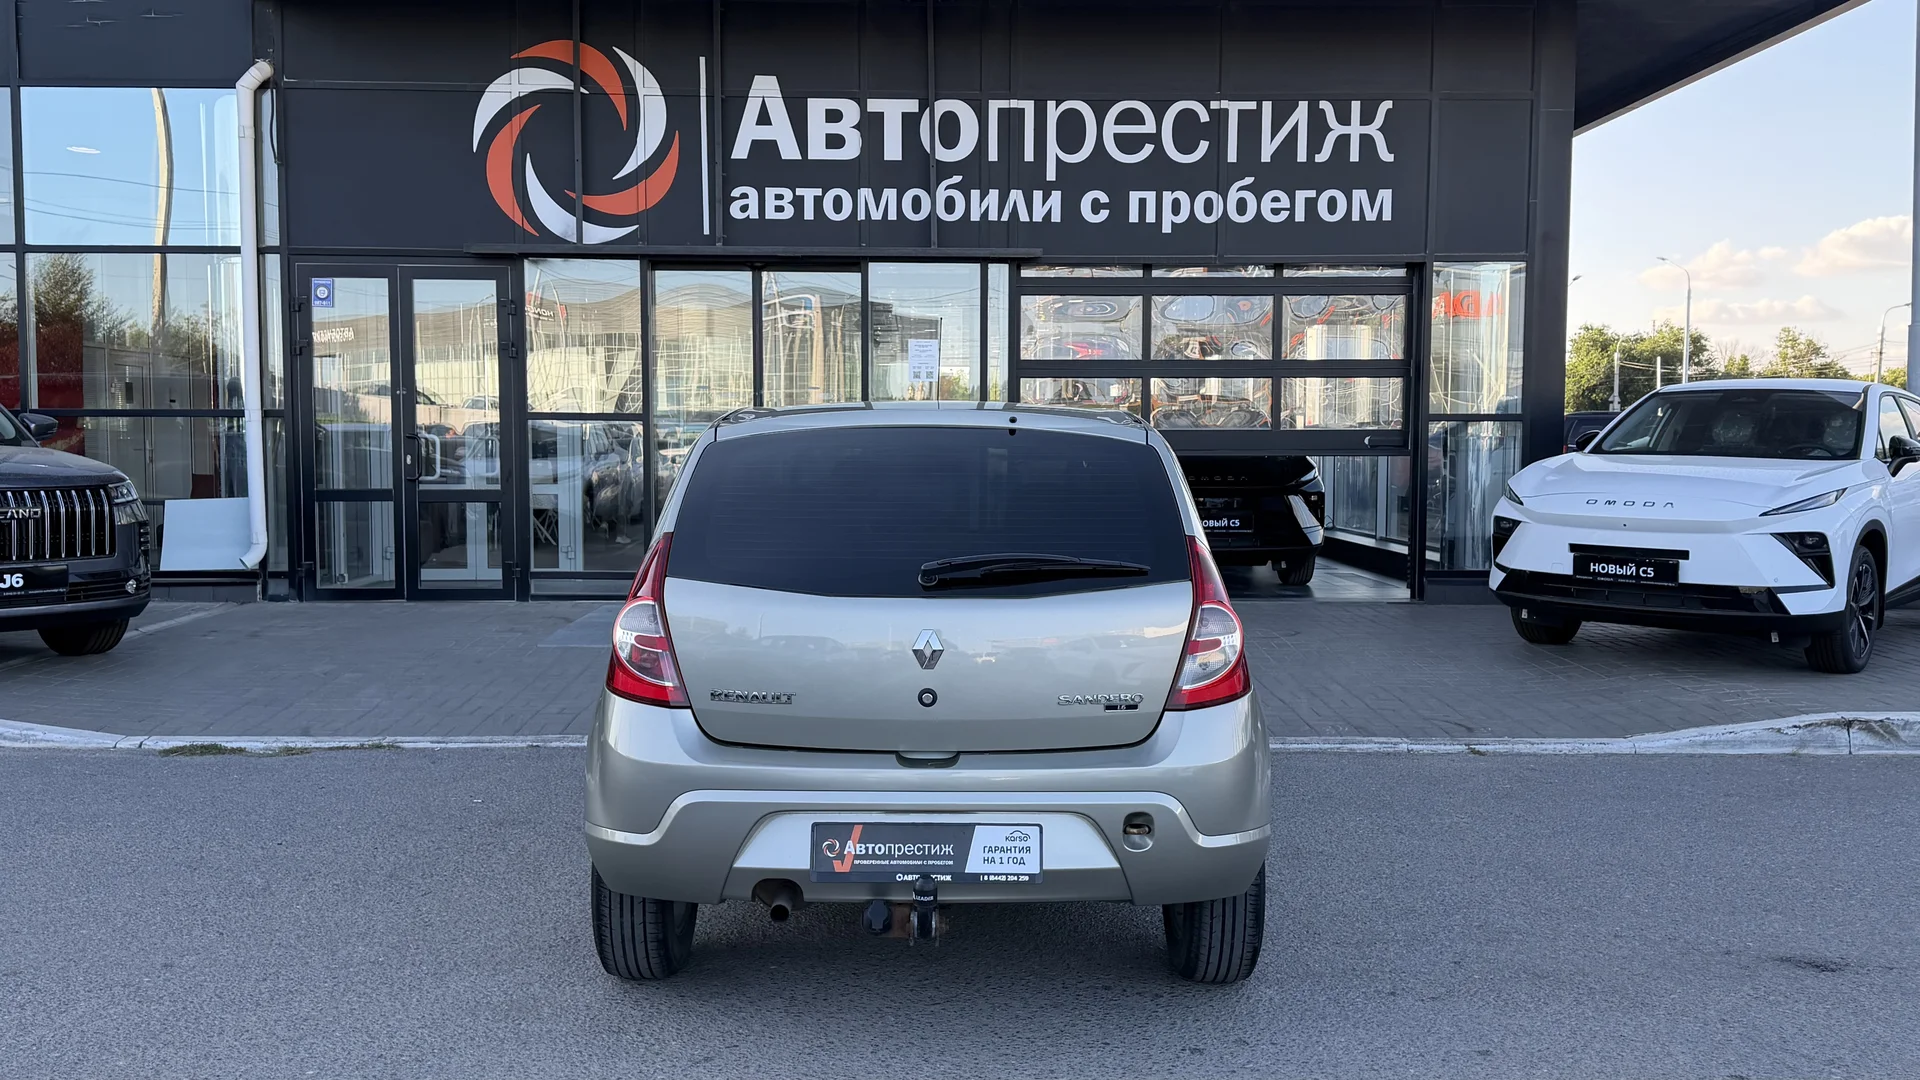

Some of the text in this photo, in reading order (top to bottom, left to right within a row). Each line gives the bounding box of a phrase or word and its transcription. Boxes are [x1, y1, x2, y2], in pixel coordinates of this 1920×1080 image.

[730, 75, 1394, 181] Автопрестиж
[729, 175, 1393, 233] автомобили с пробегом
[1586, 498, 1674, 508] OMODA
[1200, 517, 1228, 527] ОВЫЙ
[1590, 562, 1636, 576] НОВЫЙ
[710, 688, 796, 704] RENAULT
[1058, 692, 1144, 706] SANDERO
[843, 840, 954, 858] Автопрестиж
[983, 845, 1031, 854] ГАРАНТИЯ
[983, 856, 1026, 866] НА 1 ГОД
